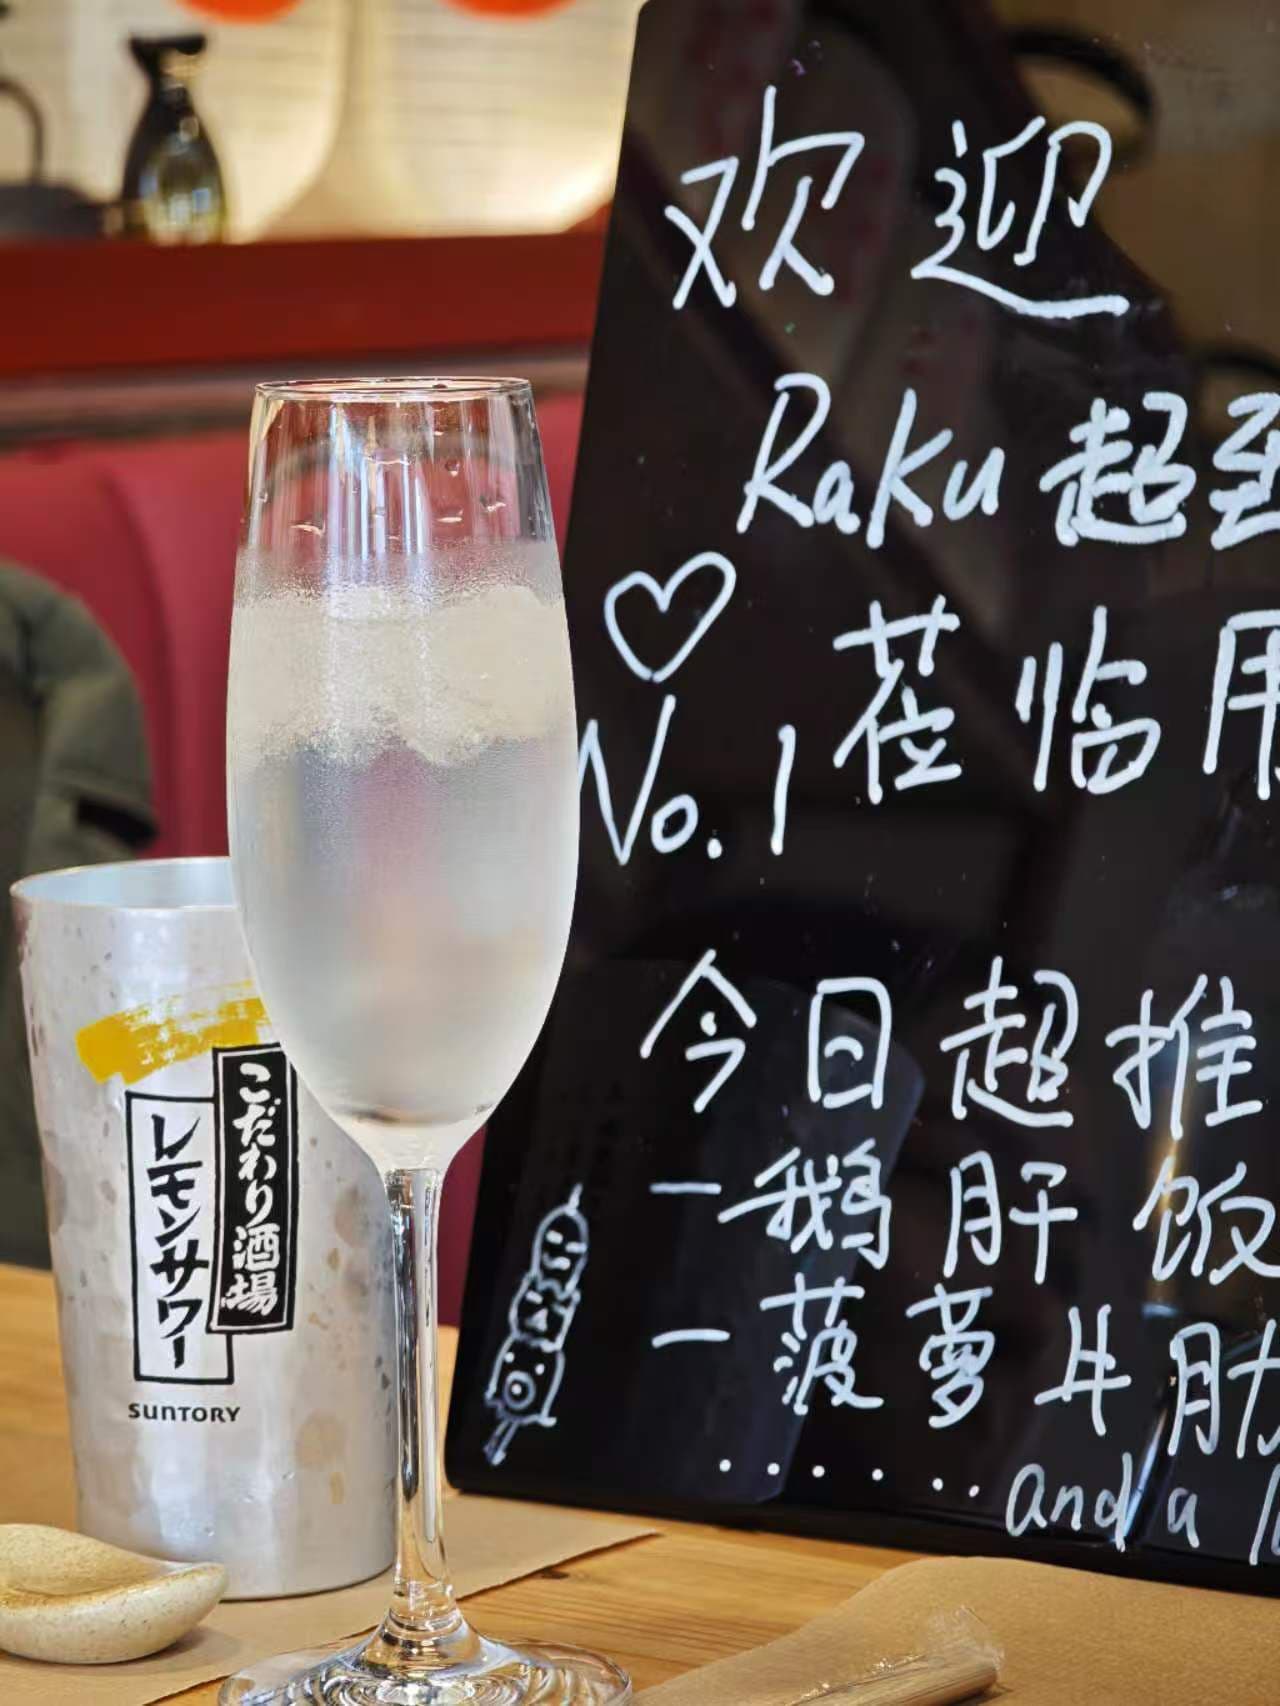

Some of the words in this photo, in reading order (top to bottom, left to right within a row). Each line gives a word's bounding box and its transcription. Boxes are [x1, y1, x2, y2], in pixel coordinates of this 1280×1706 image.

[664, 85, 1130, 319] 欢迎
[640, 949, 1263, 1141] 今日超推
[146, 1113, 209, 1369] レモンサワー
[224, 1062, 280, 1315] こだわり酒場
[128, 1402, 240, 1423] SUNTORY
[1005, 1451, 1134, 1552] and
